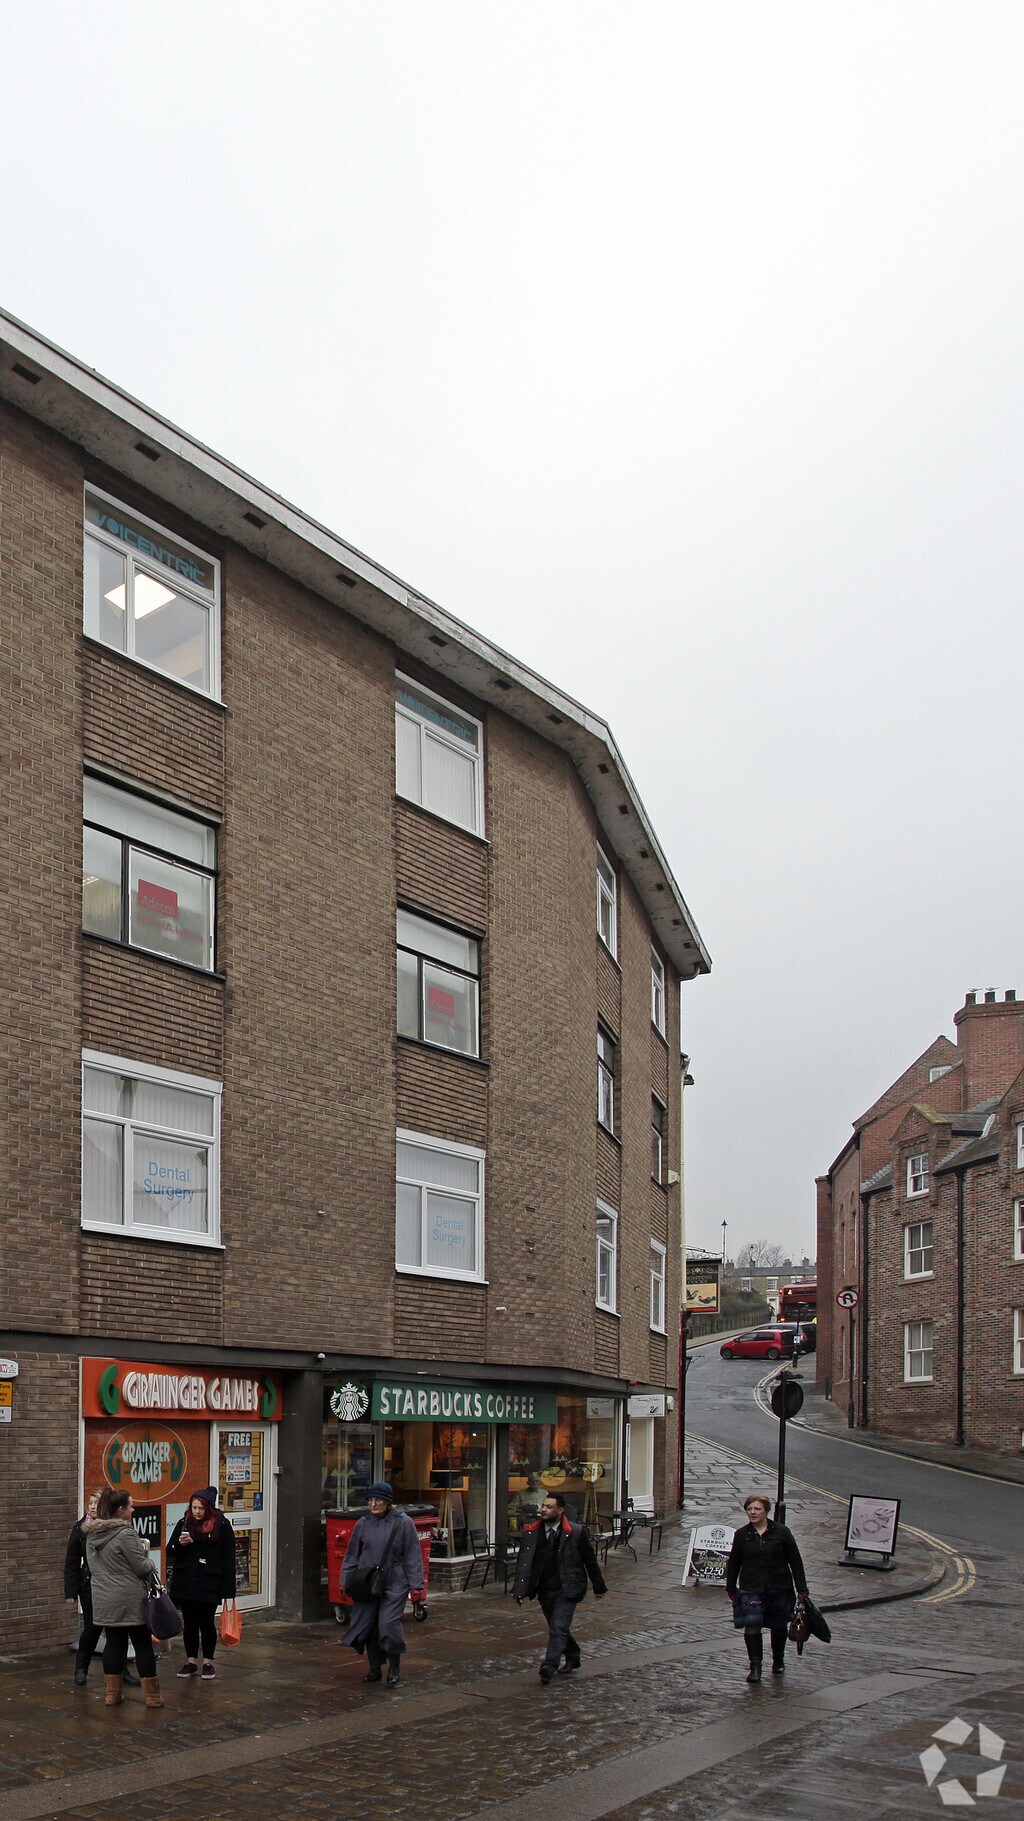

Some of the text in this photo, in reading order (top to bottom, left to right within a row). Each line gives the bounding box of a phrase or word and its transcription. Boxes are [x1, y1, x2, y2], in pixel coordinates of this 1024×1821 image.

[93, 508, 205, 587] VOICENTRIC
[143, 895, 175, 914] Adecco
[148, 1161, 190, 1182] Dental
[143, 1178, 195, 1204] Surgery
[436, 1215, 464, 1231] Dental
[432, 1228, 467, 1248] Surgery
[122, 1371, 260, 1411] GRAINGER GAMES
[380, 1386, 535, 1419] STARBUCKS COFFEE
[228, 1432, 251, 1447] FREE
[122, 1441, 171, 1463] GRAINGER
[130, 1462, 163, 1484] GAMES
[133, 1515, 157, 1535] Wii
